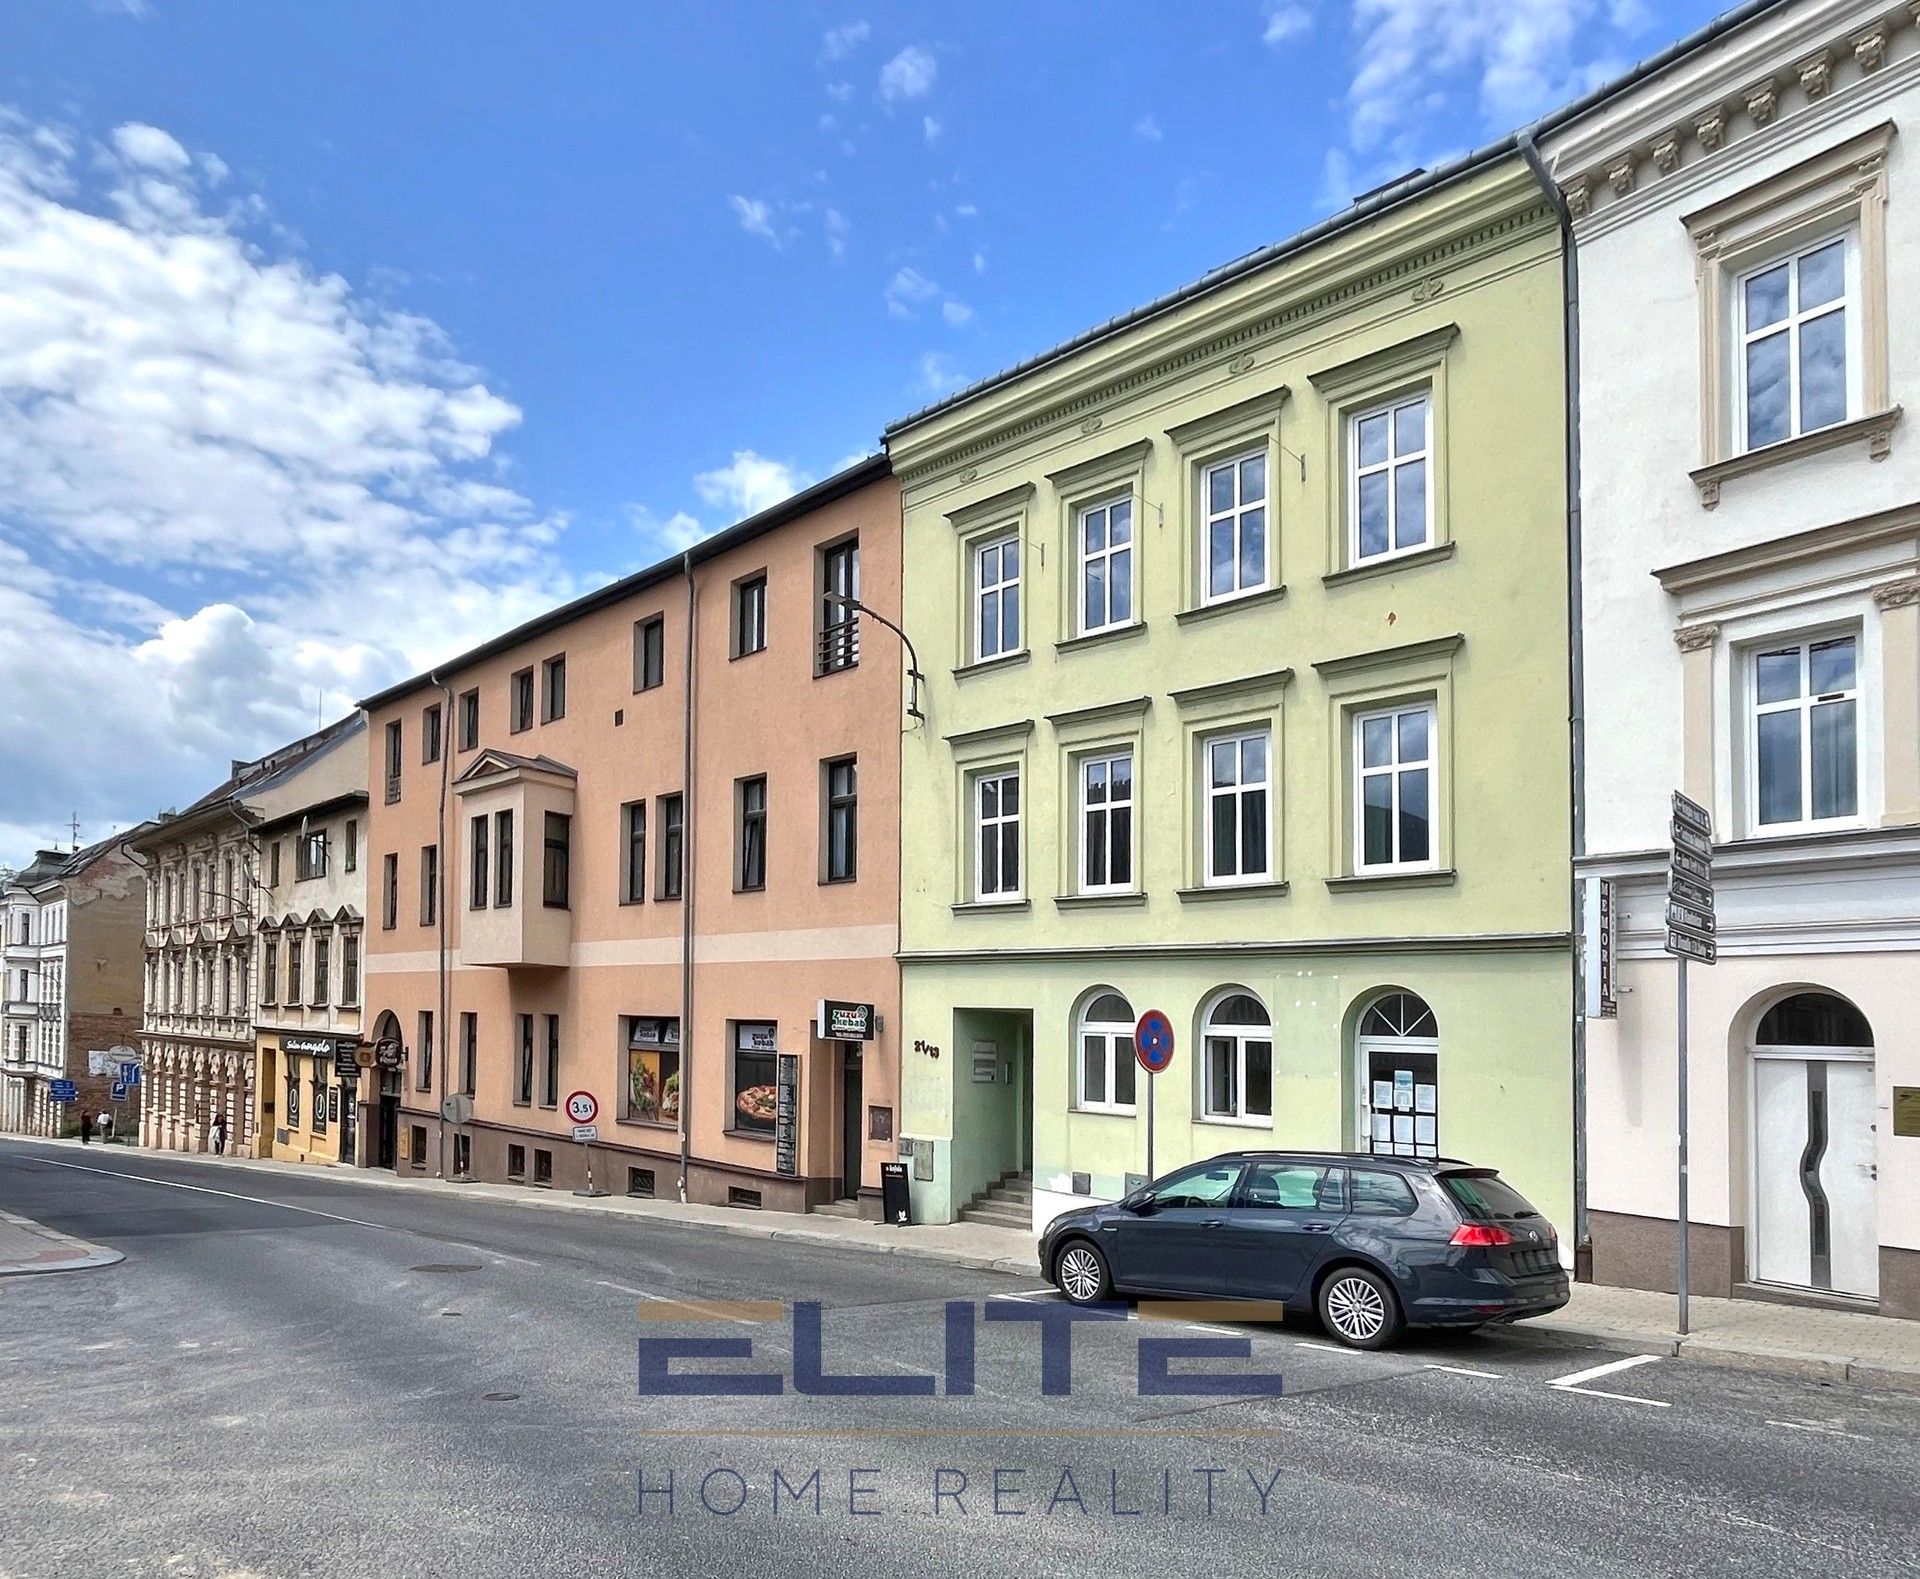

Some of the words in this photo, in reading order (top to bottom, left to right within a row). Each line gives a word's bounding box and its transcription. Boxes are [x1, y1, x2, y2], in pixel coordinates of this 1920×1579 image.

[1601, 881, 1609, 997] MEMORIA
[833, 1010, 857, 1019] zuzu
[835, 1018, 866, 1028] kebab
